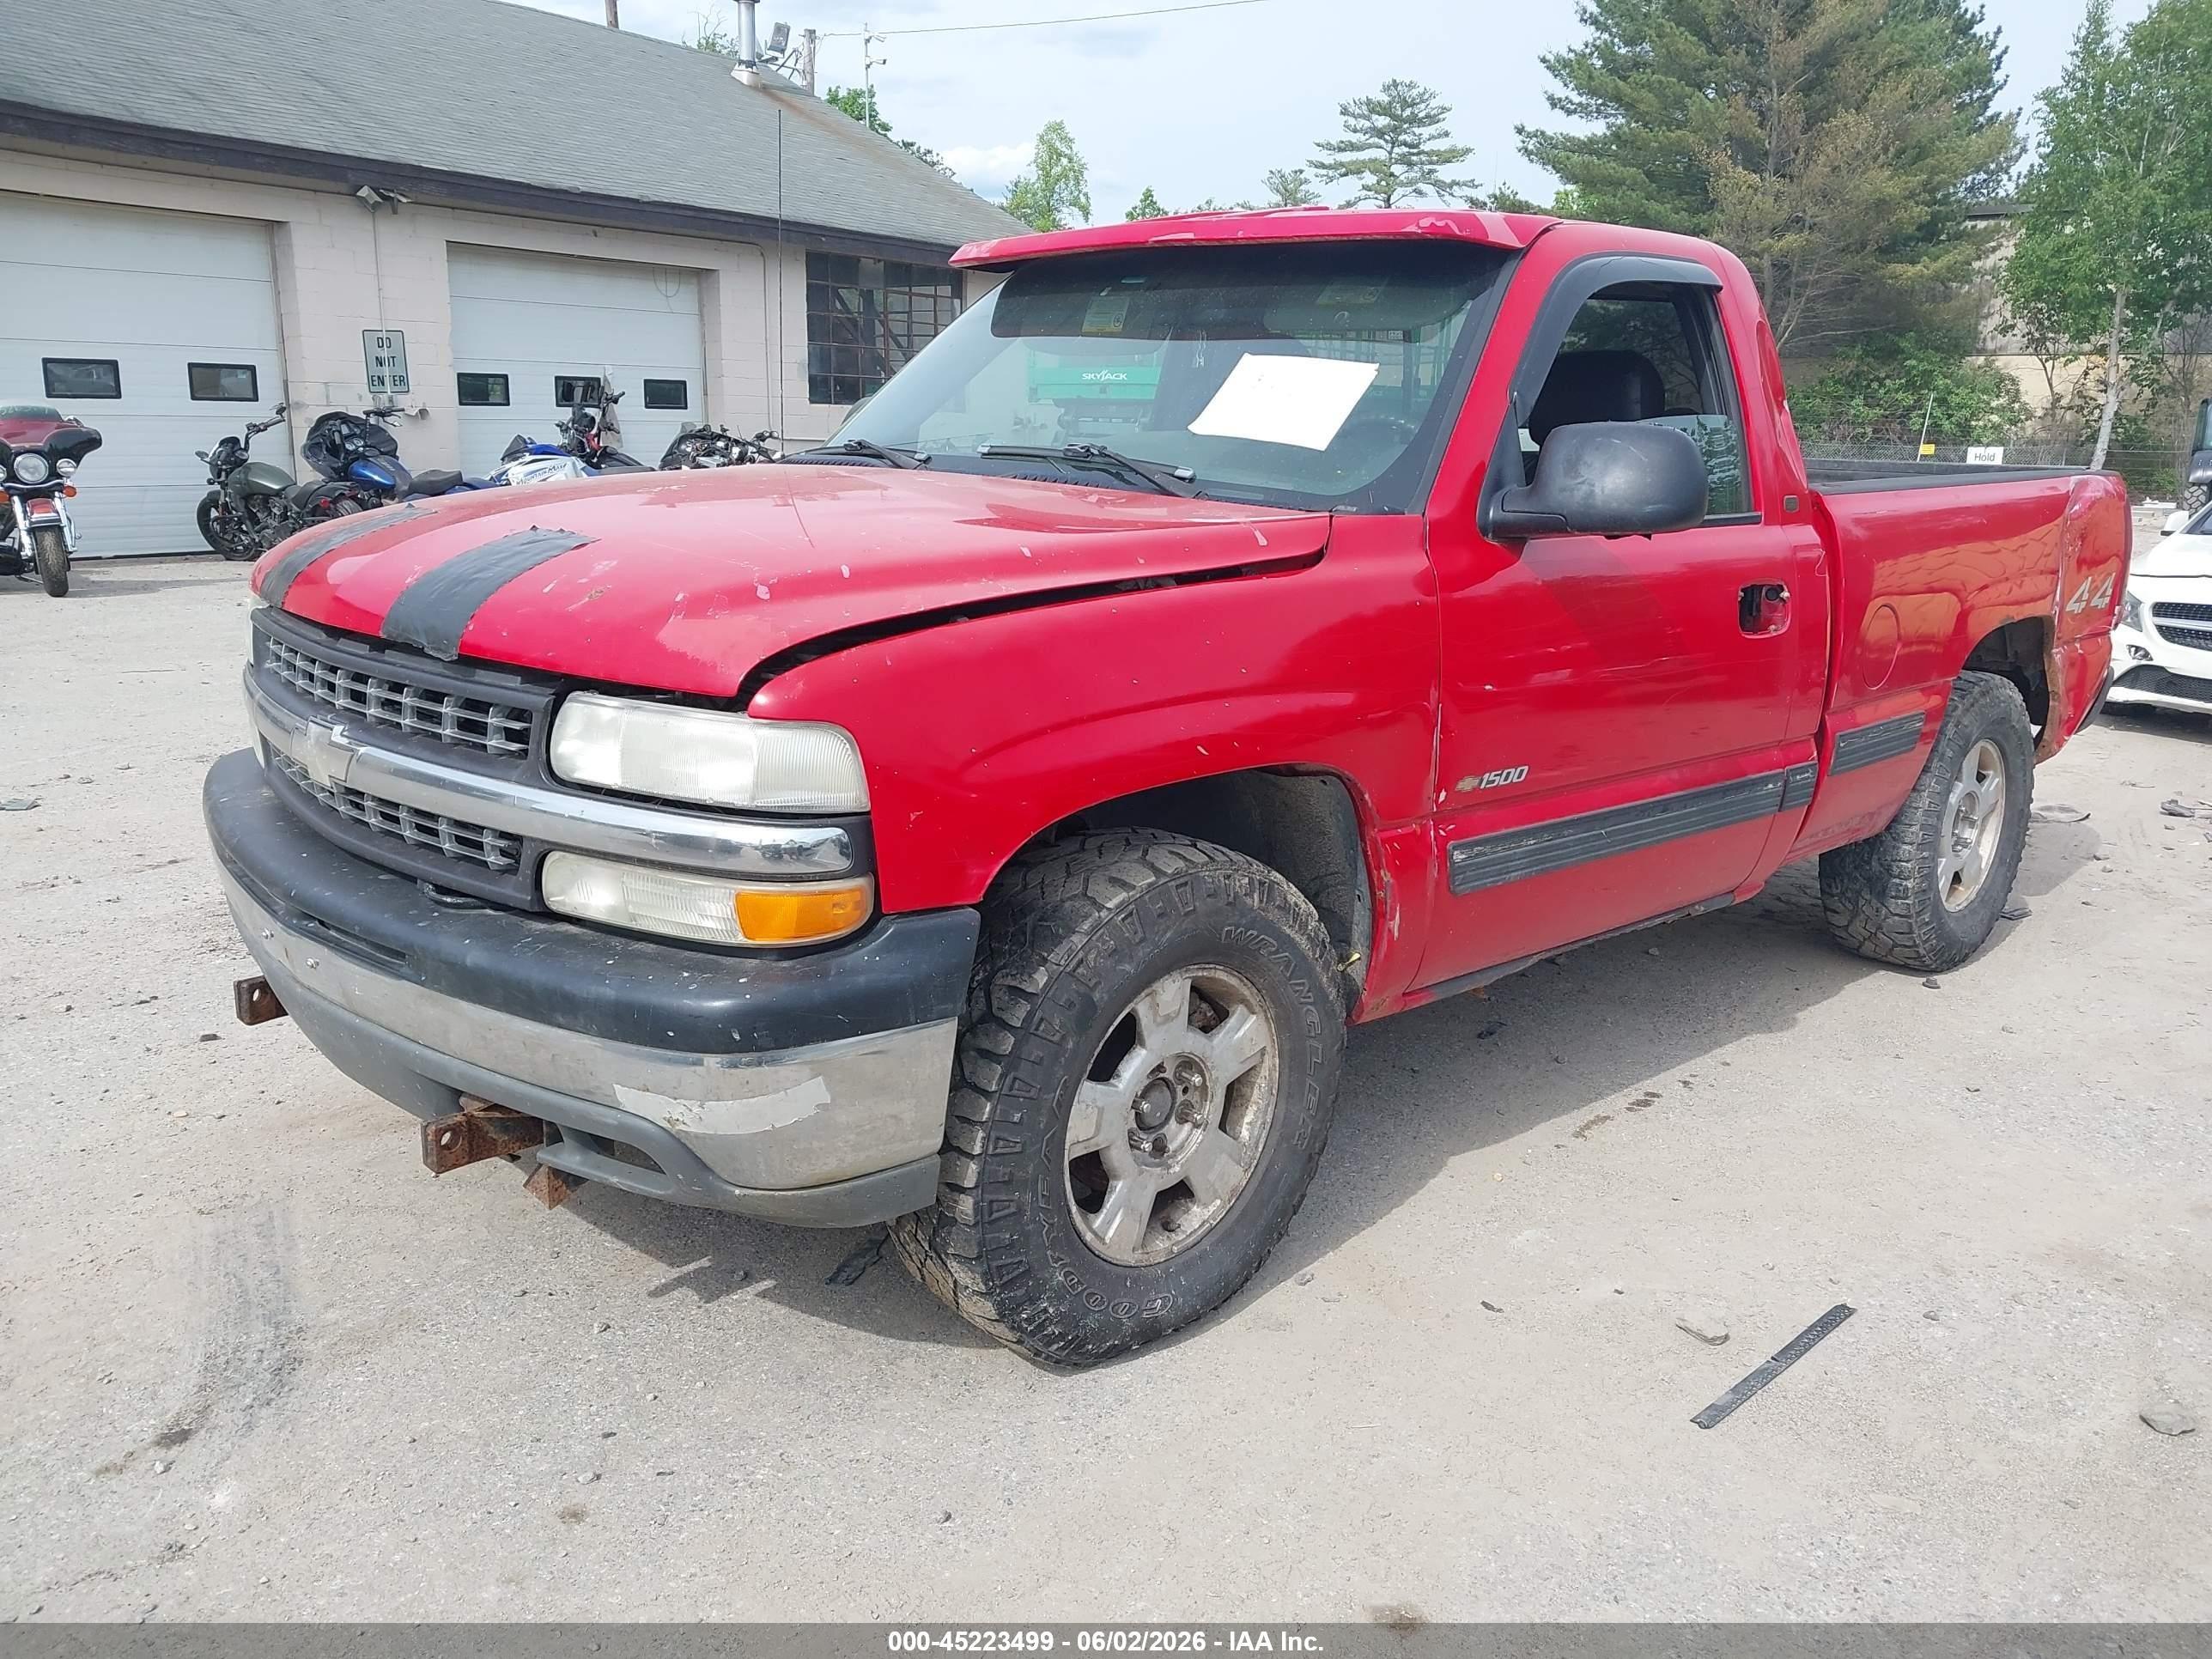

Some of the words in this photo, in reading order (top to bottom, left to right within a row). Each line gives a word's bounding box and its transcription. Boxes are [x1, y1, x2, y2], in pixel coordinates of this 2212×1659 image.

[376, 337, 392, 349] DO
[375, 356, 397, 368] NOT
[1082, 369, 1127, 381] SKYJACK
[1974, 453, 1996, 462] Hold
[1479, 764, 1529, 789] 1500
[1221, 927, 1324, 1150] WRANGLER
[1038, 1075, 1174, 1319] GOODYEAR
